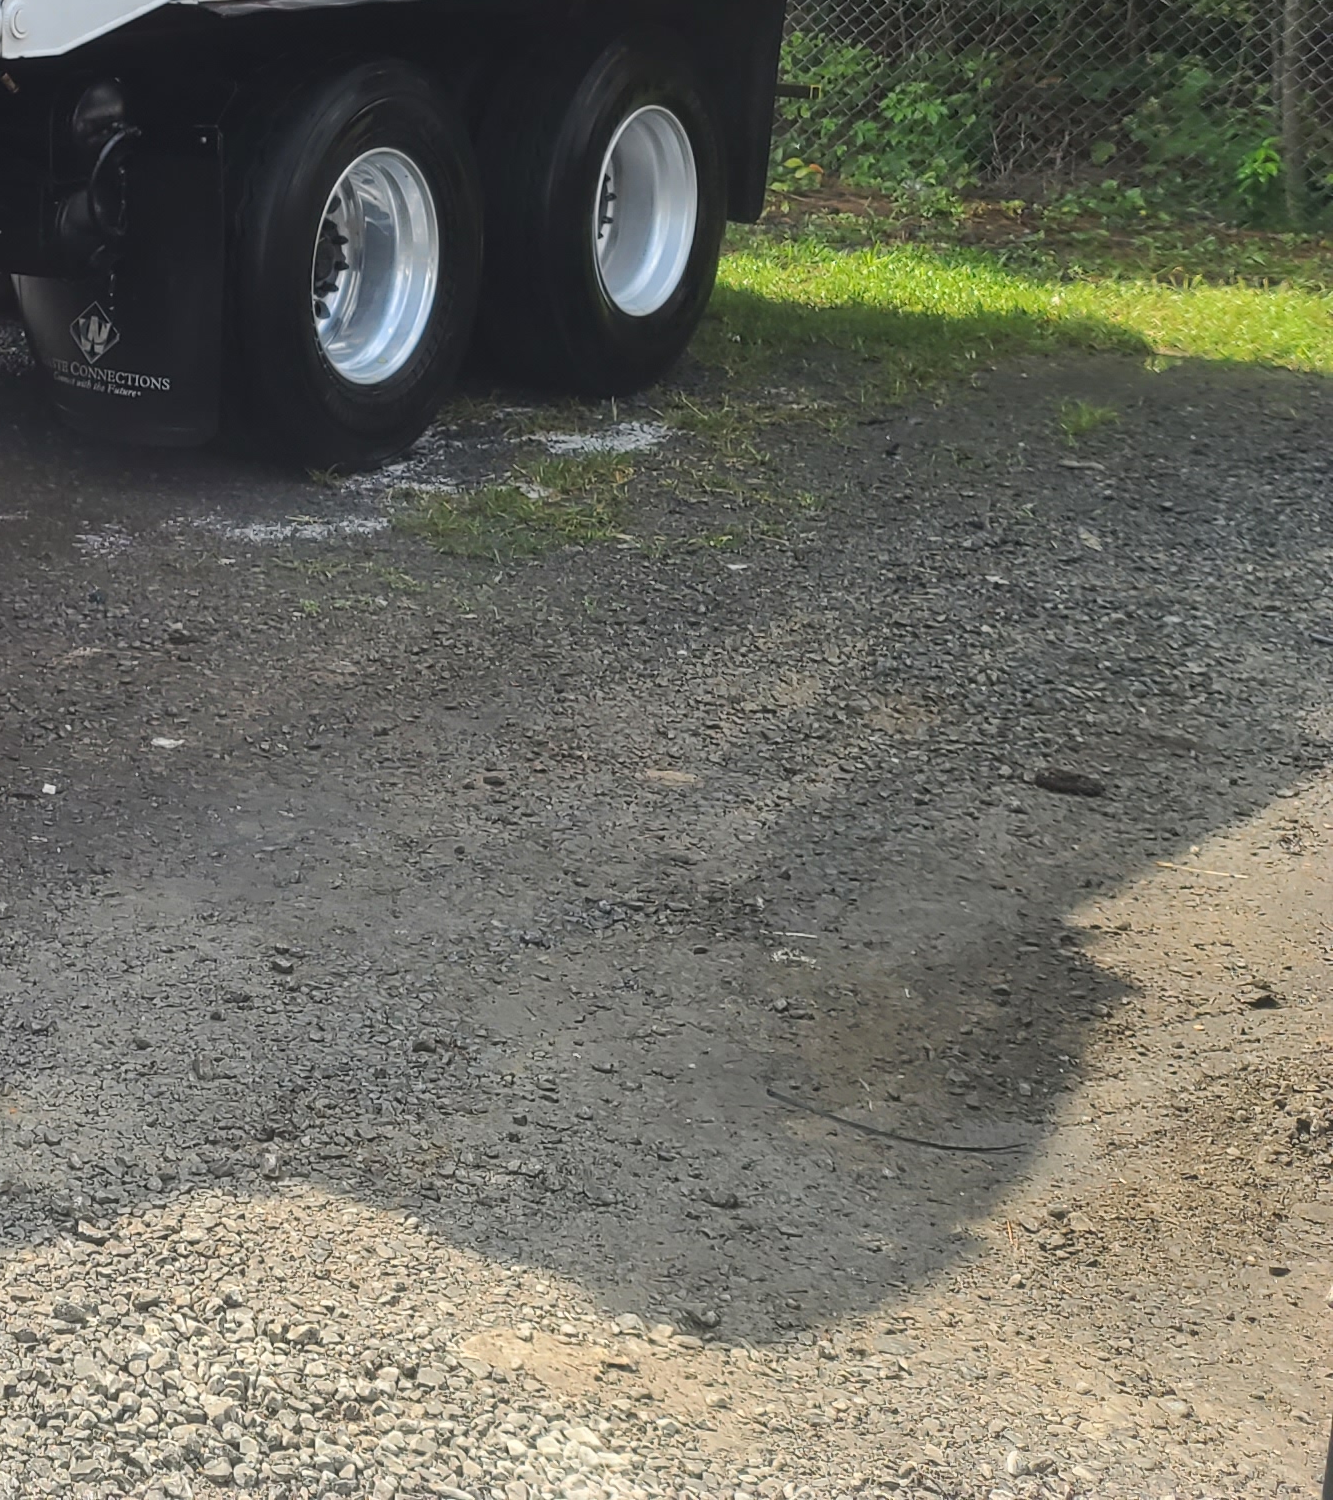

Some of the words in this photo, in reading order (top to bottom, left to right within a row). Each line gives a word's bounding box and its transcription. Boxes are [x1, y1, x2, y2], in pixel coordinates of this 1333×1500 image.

[70, 361, 170, 391] CONNECTIONS
[76, 378, 91, 389] with
[93, 382, 105, 393] the
